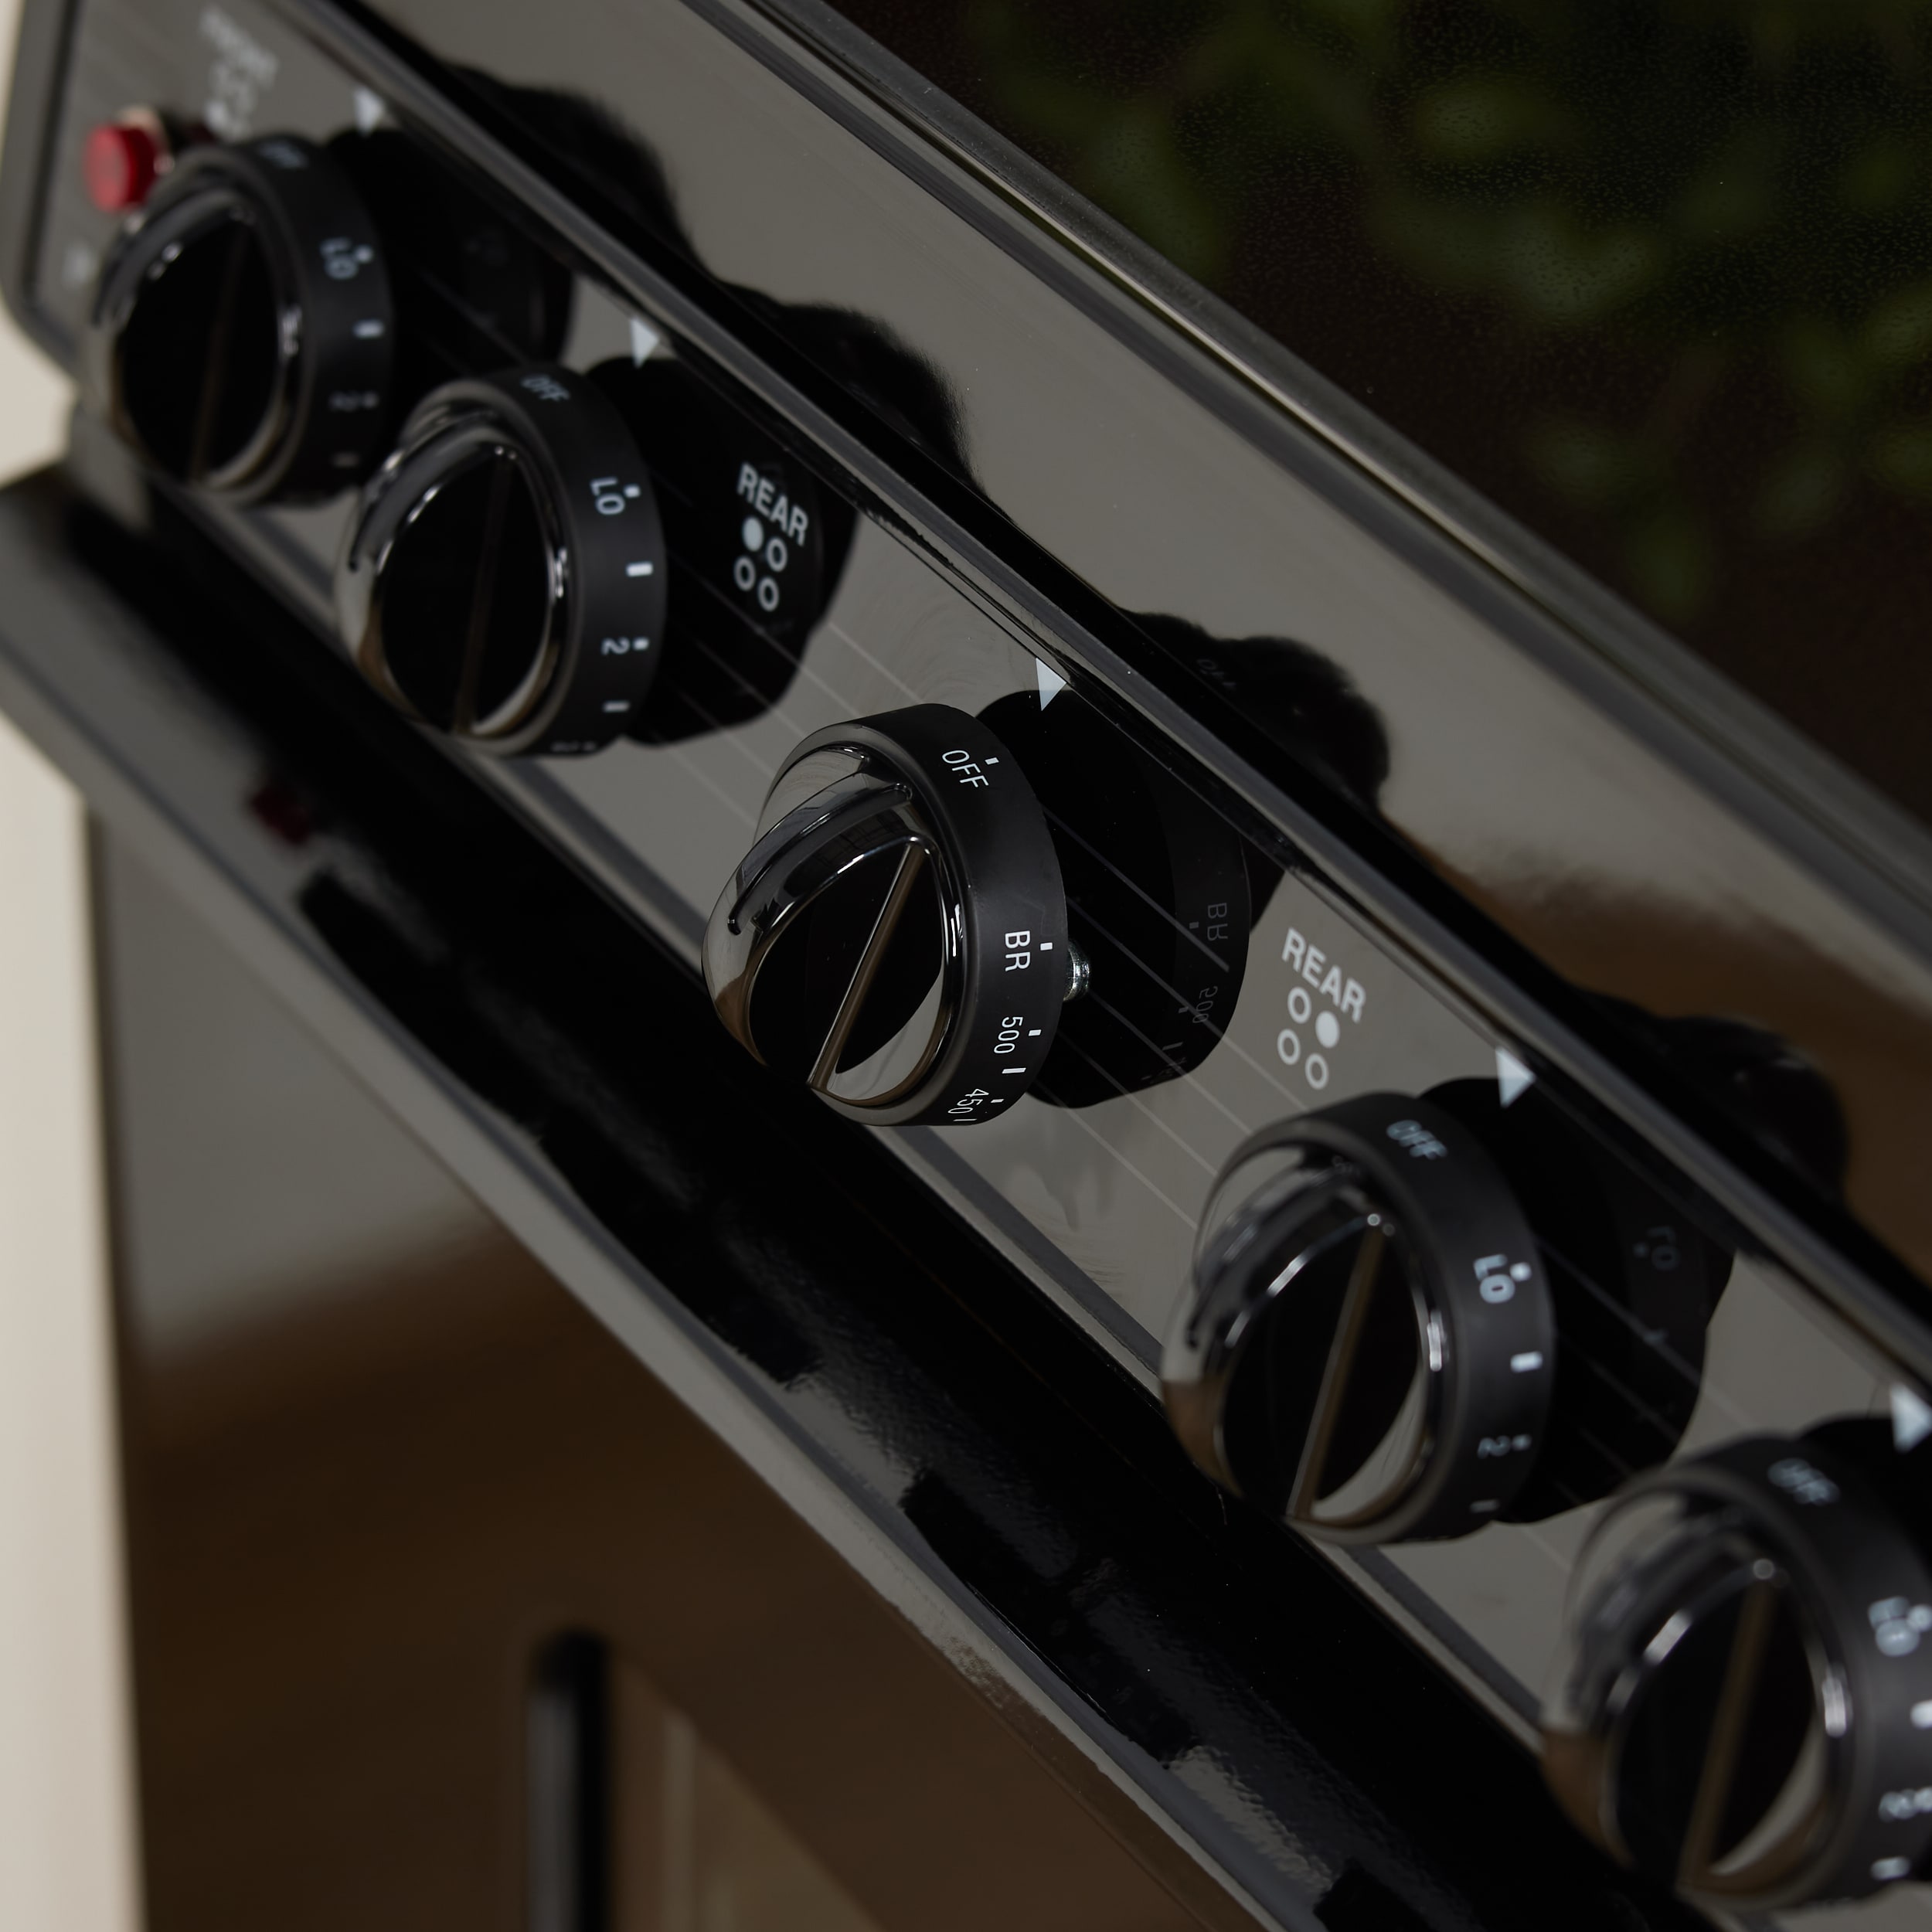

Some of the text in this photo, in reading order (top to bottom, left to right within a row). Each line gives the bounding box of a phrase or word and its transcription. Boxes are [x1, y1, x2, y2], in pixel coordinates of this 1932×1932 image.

[590, 476, 625, 515] LO
[736, 461, 809, 546] REAR
[600, 638, 631, 655] 2
[942, 750, 989, 787] OFF
[1005, 930, 1031, 971] BR
[1282, 927, 1366, 1023] REAR
[994, 1016, 1023, 1054] 500
[947, 1088, 989, 1114] 450
[1386, 1119, 1447, 1160] OFF
[1473, 1253, 1515, 1304] LO
[1477, 1435, 1512, 1459] 2
